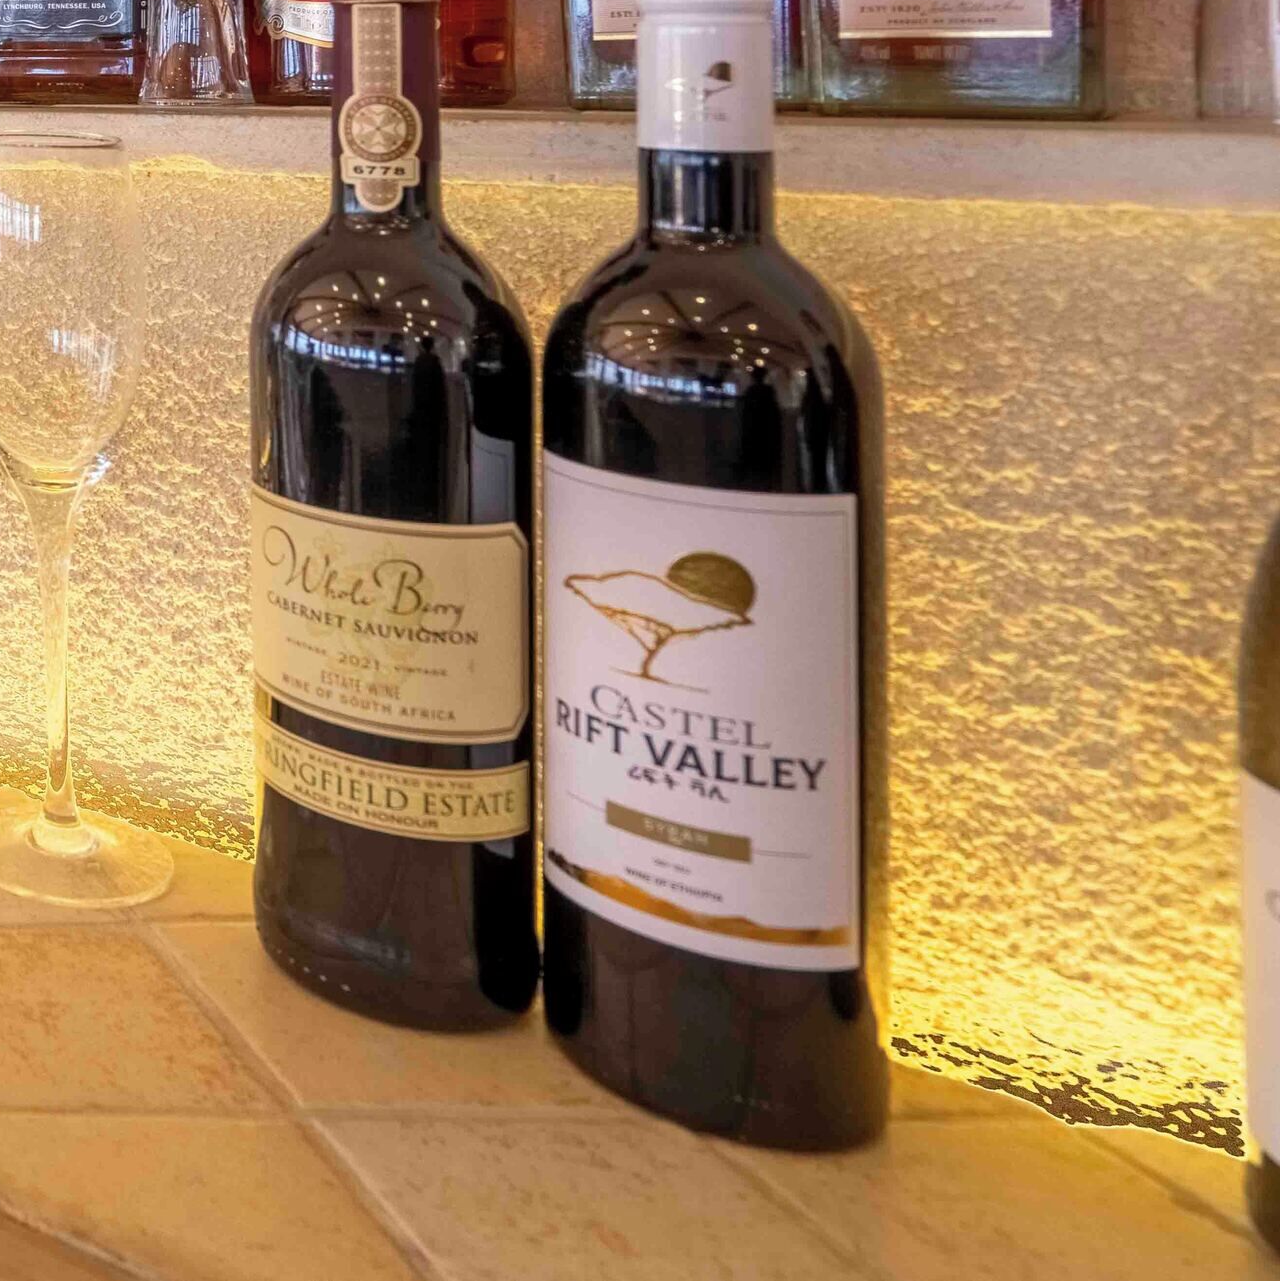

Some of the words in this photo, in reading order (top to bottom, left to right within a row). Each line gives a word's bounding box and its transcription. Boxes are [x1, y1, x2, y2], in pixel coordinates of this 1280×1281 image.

[91, 1, 107, 10] USA
[289, 6, 321, 15] PRODUCE
[352, 165, 407, 176] 6778
[262, 525, 375, 608] Whole
[372, 558, 466, 633] Berry
[267, 590, 348, 629] CABERNET
[353, 616, 481, 645] SAUVIGNON
[339, 650, 382, 672] 2021
[281, 671, 312, 694] WINE
[315, 687, 337, 703] OF
[340, 693, 393, 715] SOUTH
[398, 705, 458, 722] AFRICA
[319, 669, 363, 692] ESTATE
[367, 680, 403, 701] WINE
[590, 683, 772, 750] CASTEL
[555, 696, 629, 756] RIFT
[643, 732, 827, 792] VALLEY
[262, 742, 411, 812] RINGFIELD
[423, 787, 517, 819] ESTATE
[293, 783, 333, 809] MADE
[336, 799, 363, 816] ON
[365, 805, 440, 829] HONOUR
[670, 882, 724, 903] ETHIOPIA
